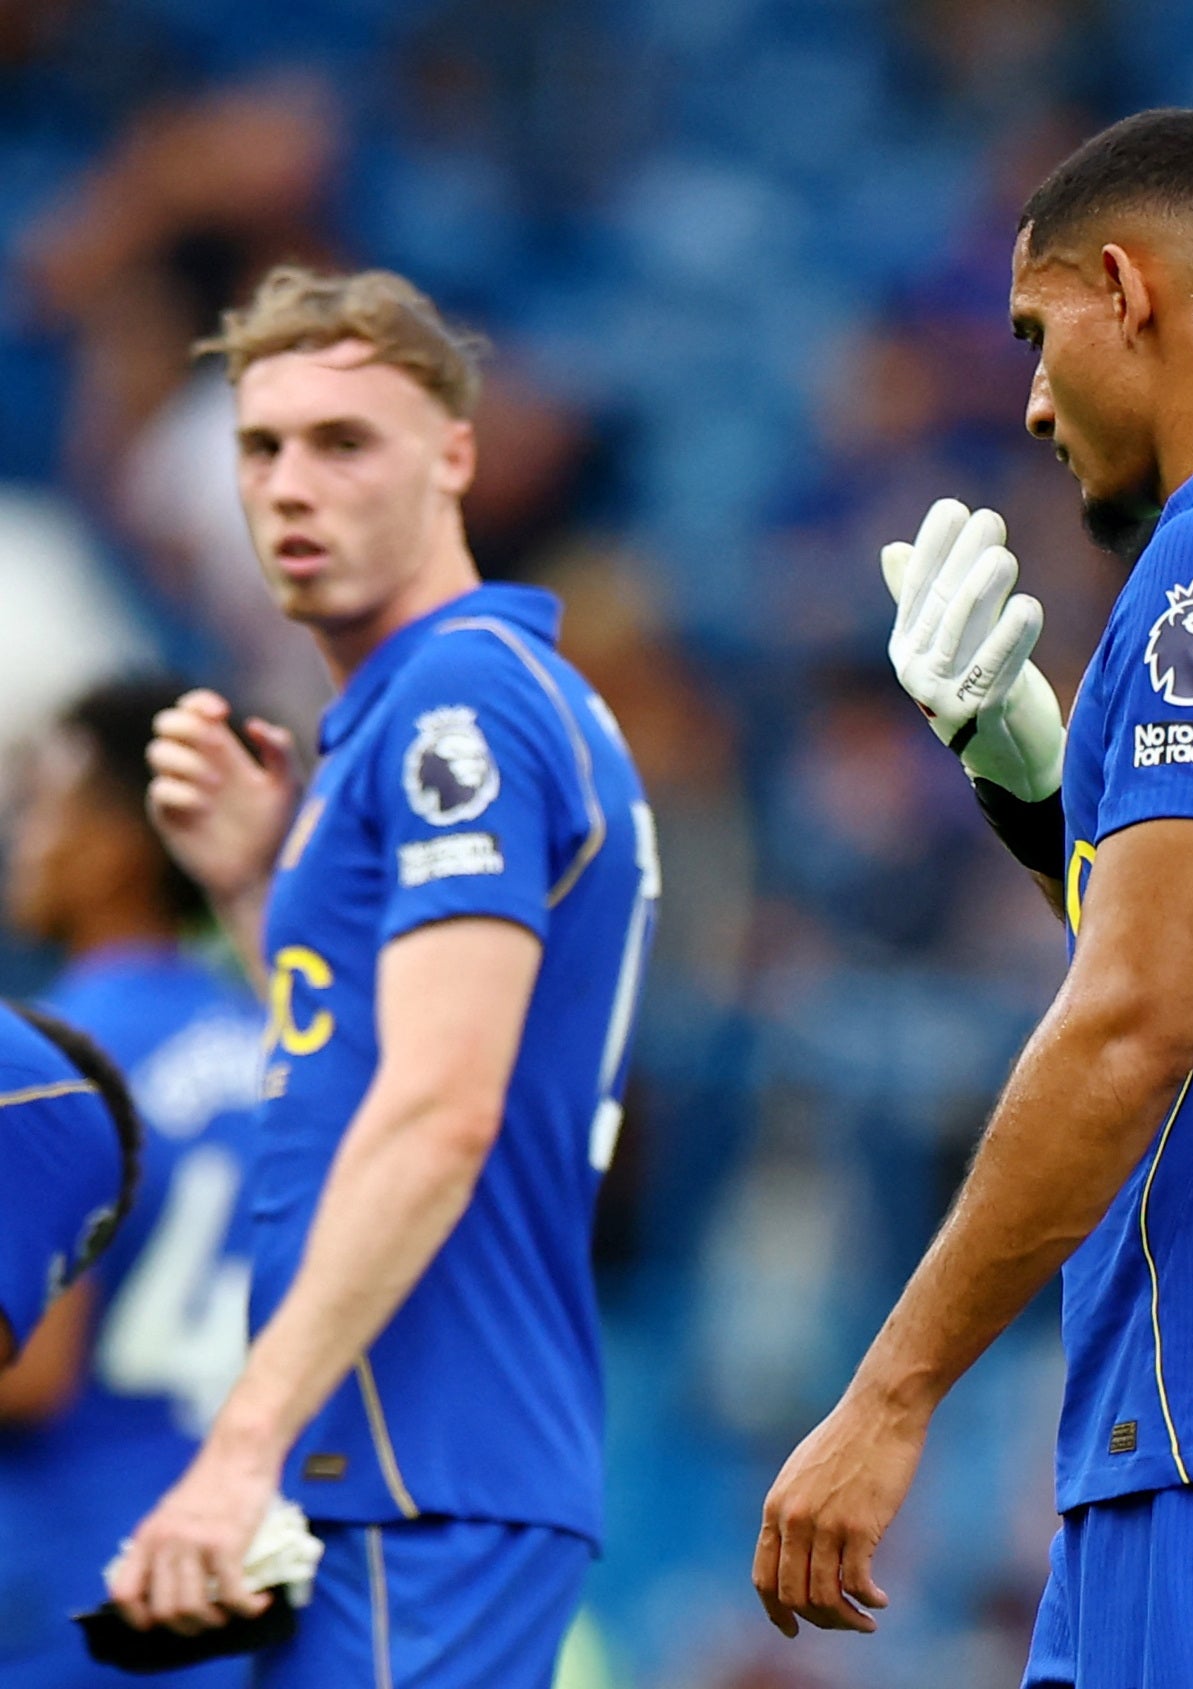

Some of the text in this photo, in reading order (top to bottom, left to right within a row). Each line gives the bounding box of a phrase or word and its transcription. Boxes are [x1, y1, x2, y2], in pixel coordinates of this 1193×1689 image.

[957, 664, 982, 701] PRED
[1134, 723, 1165, 747] No
[1133, 744, 1164, 768] for
